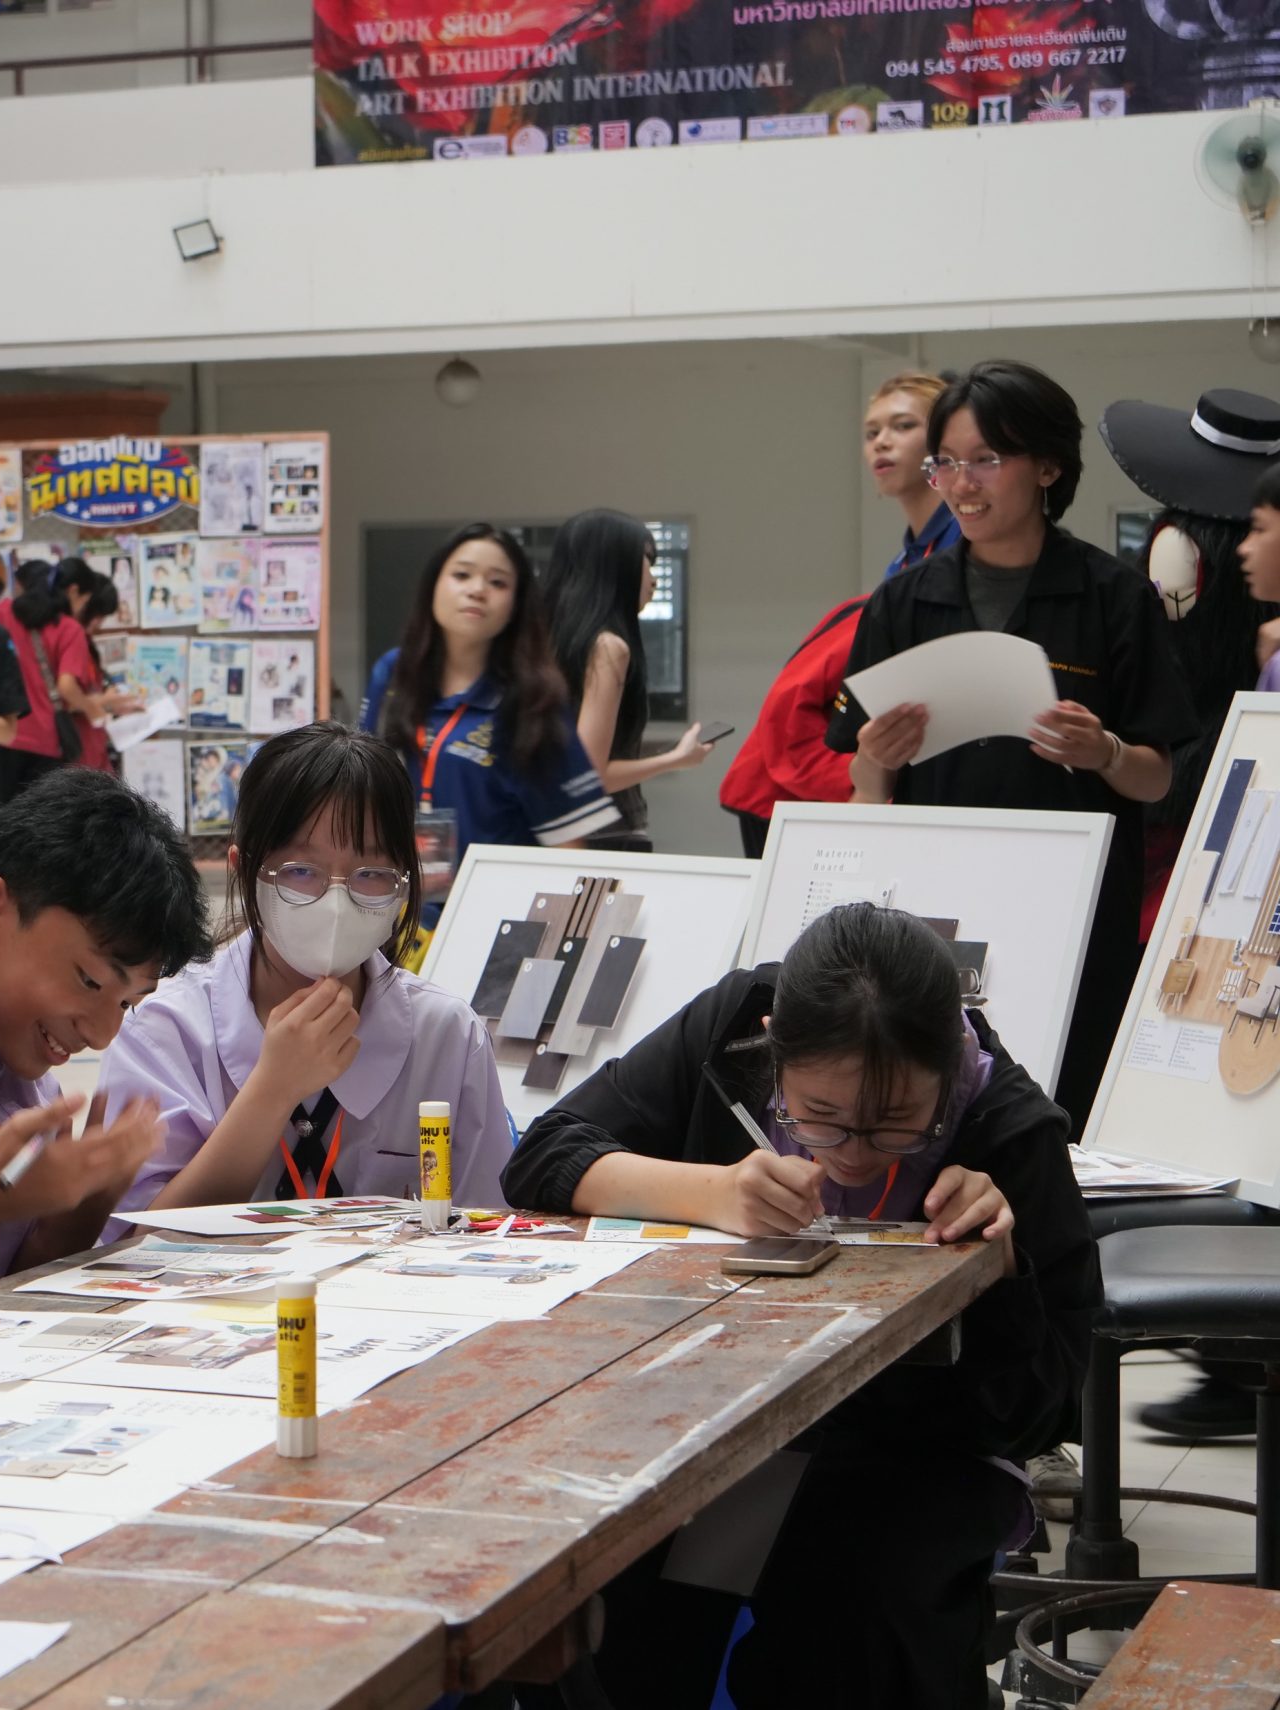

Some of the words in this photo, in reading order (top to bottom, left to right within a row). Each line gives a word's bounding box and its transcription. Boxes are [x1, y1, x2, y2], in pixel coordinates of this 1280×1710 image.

[354, 20, 431, 46] WORK
[440, 11, 513, 41] SHOP
[355, 53, 420, 83] TALK
[428, 42, 578, 77] EXHIBITION
[884, 60, 920, 78] 094
[923, 58, 957, 77] 545
[1007, 51, 1044, 70] 089
[1048, 49, 1080, 68] 667
[1086, 46, 1128, 66] 2217
[354, 91, 412, 119] ART
[415, 79, 565, 115] EXHIBITION
[572, 62, 795, 101] INTERNATIONAL
[931, 101, 969, 123] 109
[278, 1316, 306, 1332] UHU
[280, 1331, 301, 1342] stic
